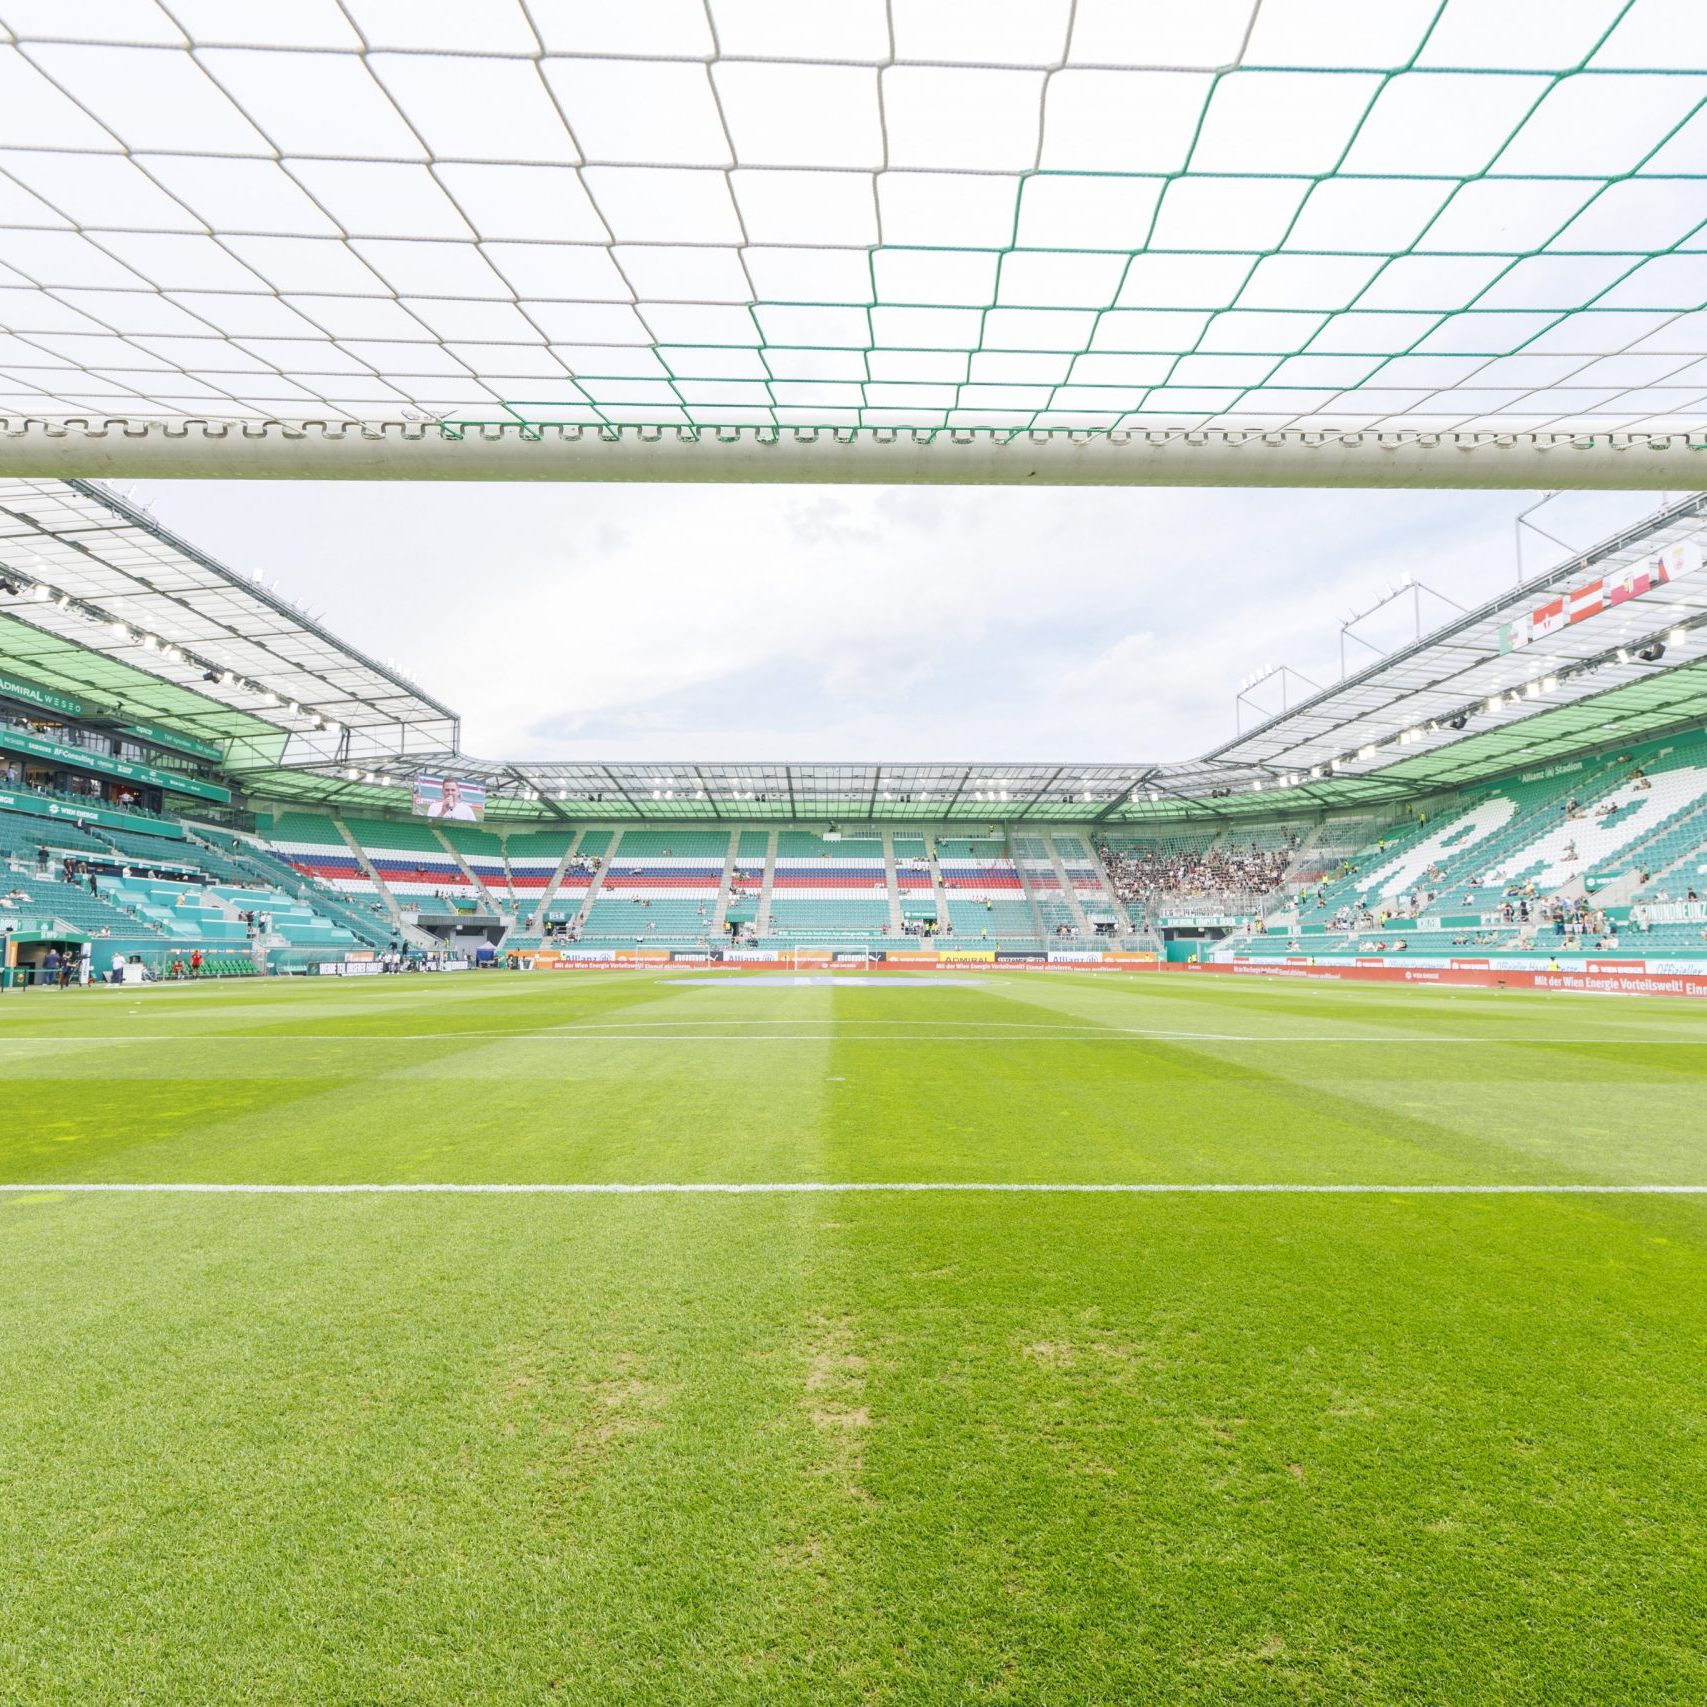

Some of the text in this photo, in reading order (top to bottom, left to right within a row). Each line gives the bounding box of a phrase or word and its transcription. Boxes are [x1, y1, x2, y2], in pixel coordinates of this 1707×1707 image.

[1534, 975, 1548, 986] Mit
[1549, 975, 1562, 987] der
[1563, 976, 1584, 988] Wien
[1586, 977, 1620, 991] Energie
[1620, 978, 1683, 993] Vorteilswelt!
